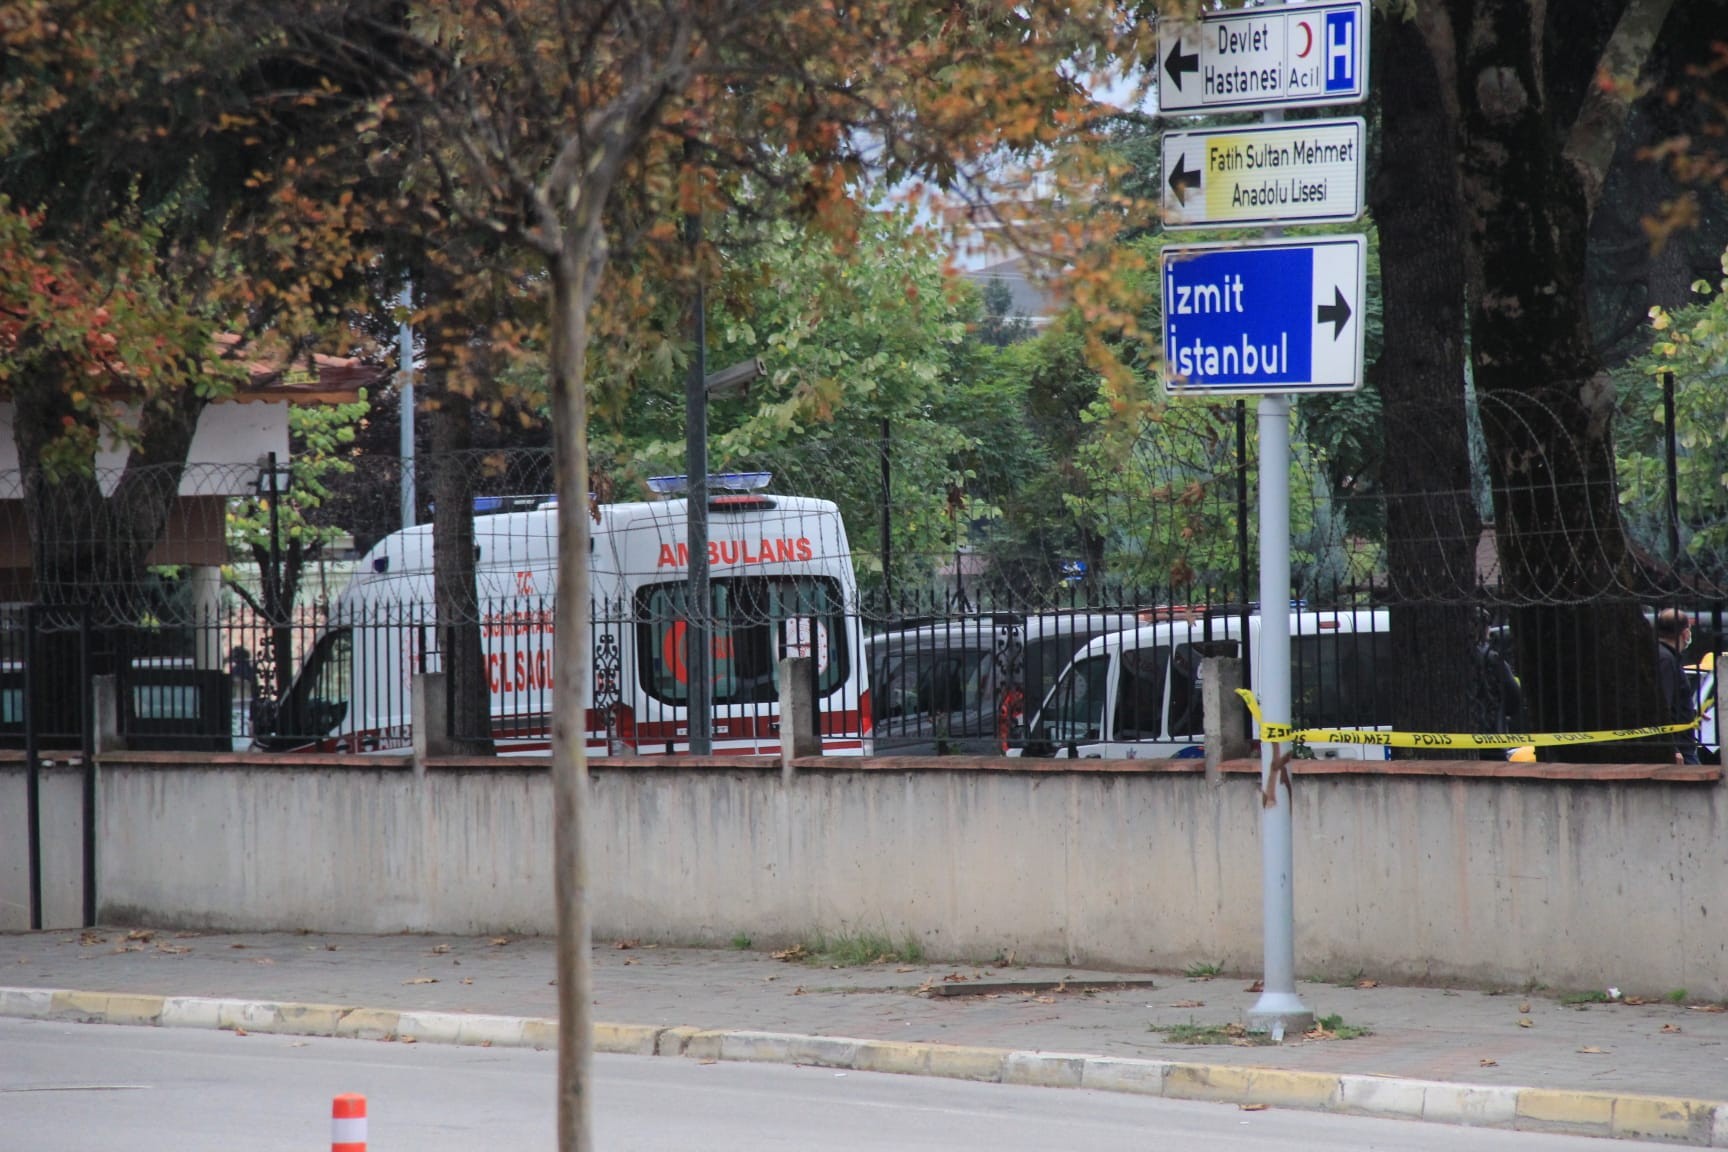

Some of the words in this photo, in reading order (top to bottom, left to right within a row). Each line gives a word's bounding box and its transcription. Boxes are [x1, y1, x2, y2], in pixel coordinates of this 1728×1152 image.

[1219, 23, 1268, 55] Devlet
[1328, 22, 1352, 81] H
[1204, 62, 1283, 95] Hastanesi
[1289, 66, 1319, 88] Acil
[1210, 146, 1243, 172] Fatih
[1246, 143, 1289, 169] Sultan
[1293, 138, 1353, 165] Mehmet
[1232, 180, 1287, 208] Anadolu
[1291, 178, 1327, 203] Lisesi
[1168, 263, 1244, 314] İzmit
[1171, 324, 1287, 376] İstanbul
